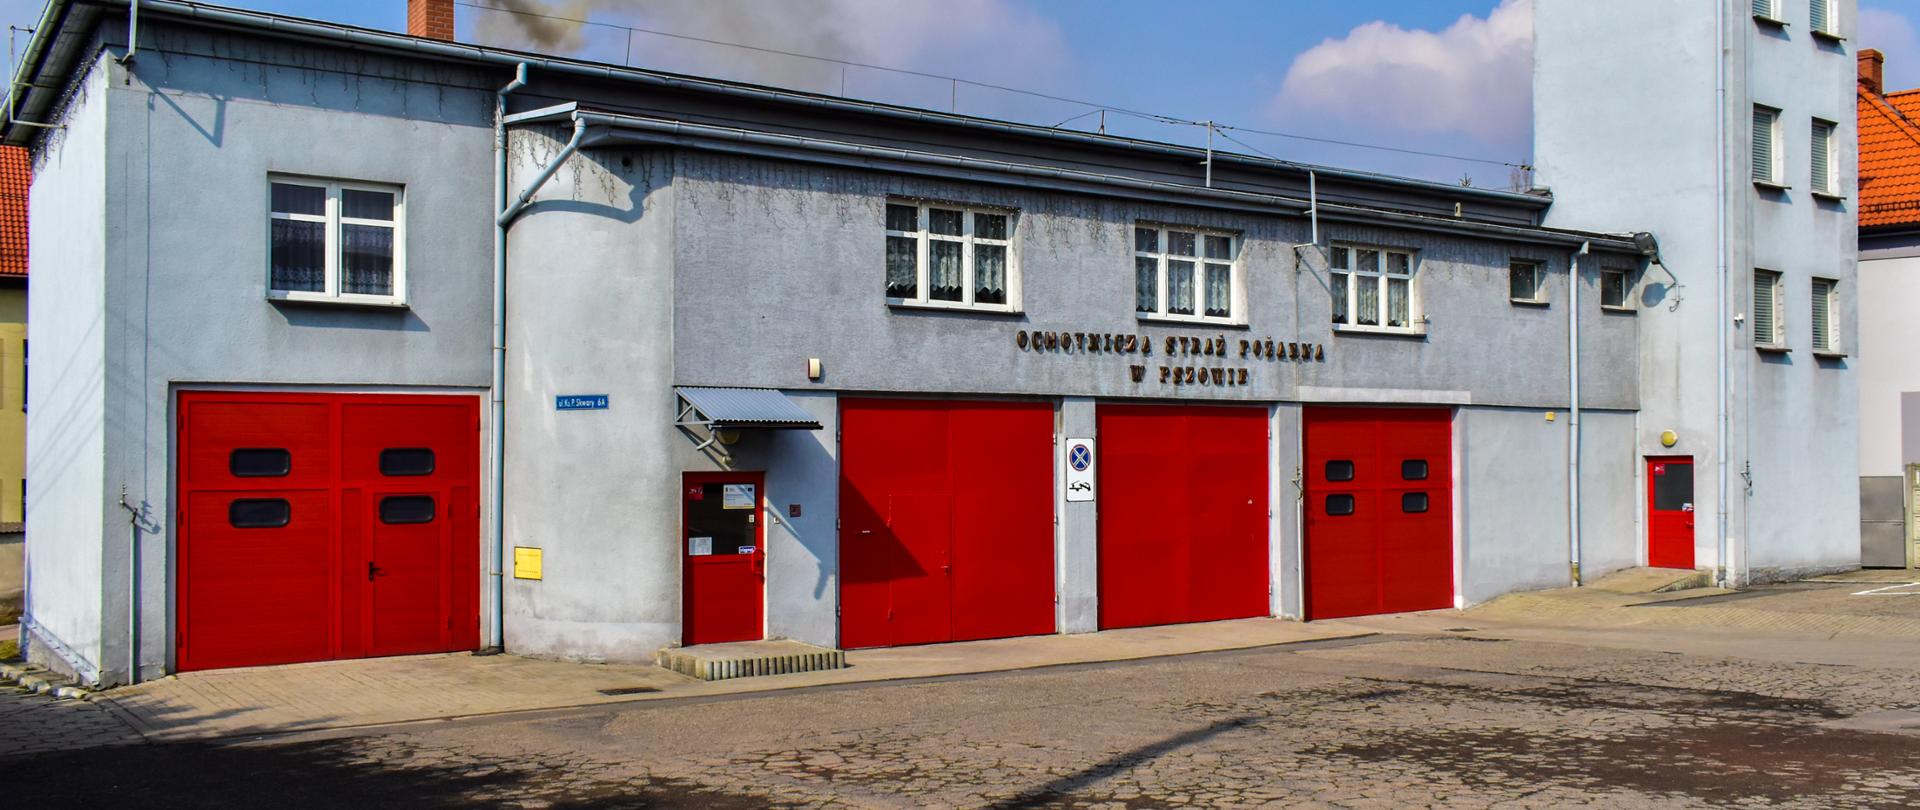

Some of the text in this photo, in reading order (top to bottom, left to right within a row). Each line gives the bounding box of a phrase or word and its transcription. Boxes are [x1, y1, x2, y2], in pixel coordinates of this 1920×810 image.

[1016, 330, 1324, 361] OCHOTNICZA STRAŻ POŻARNA
[1130, 365, 1248, 385] W PSZOWIE
